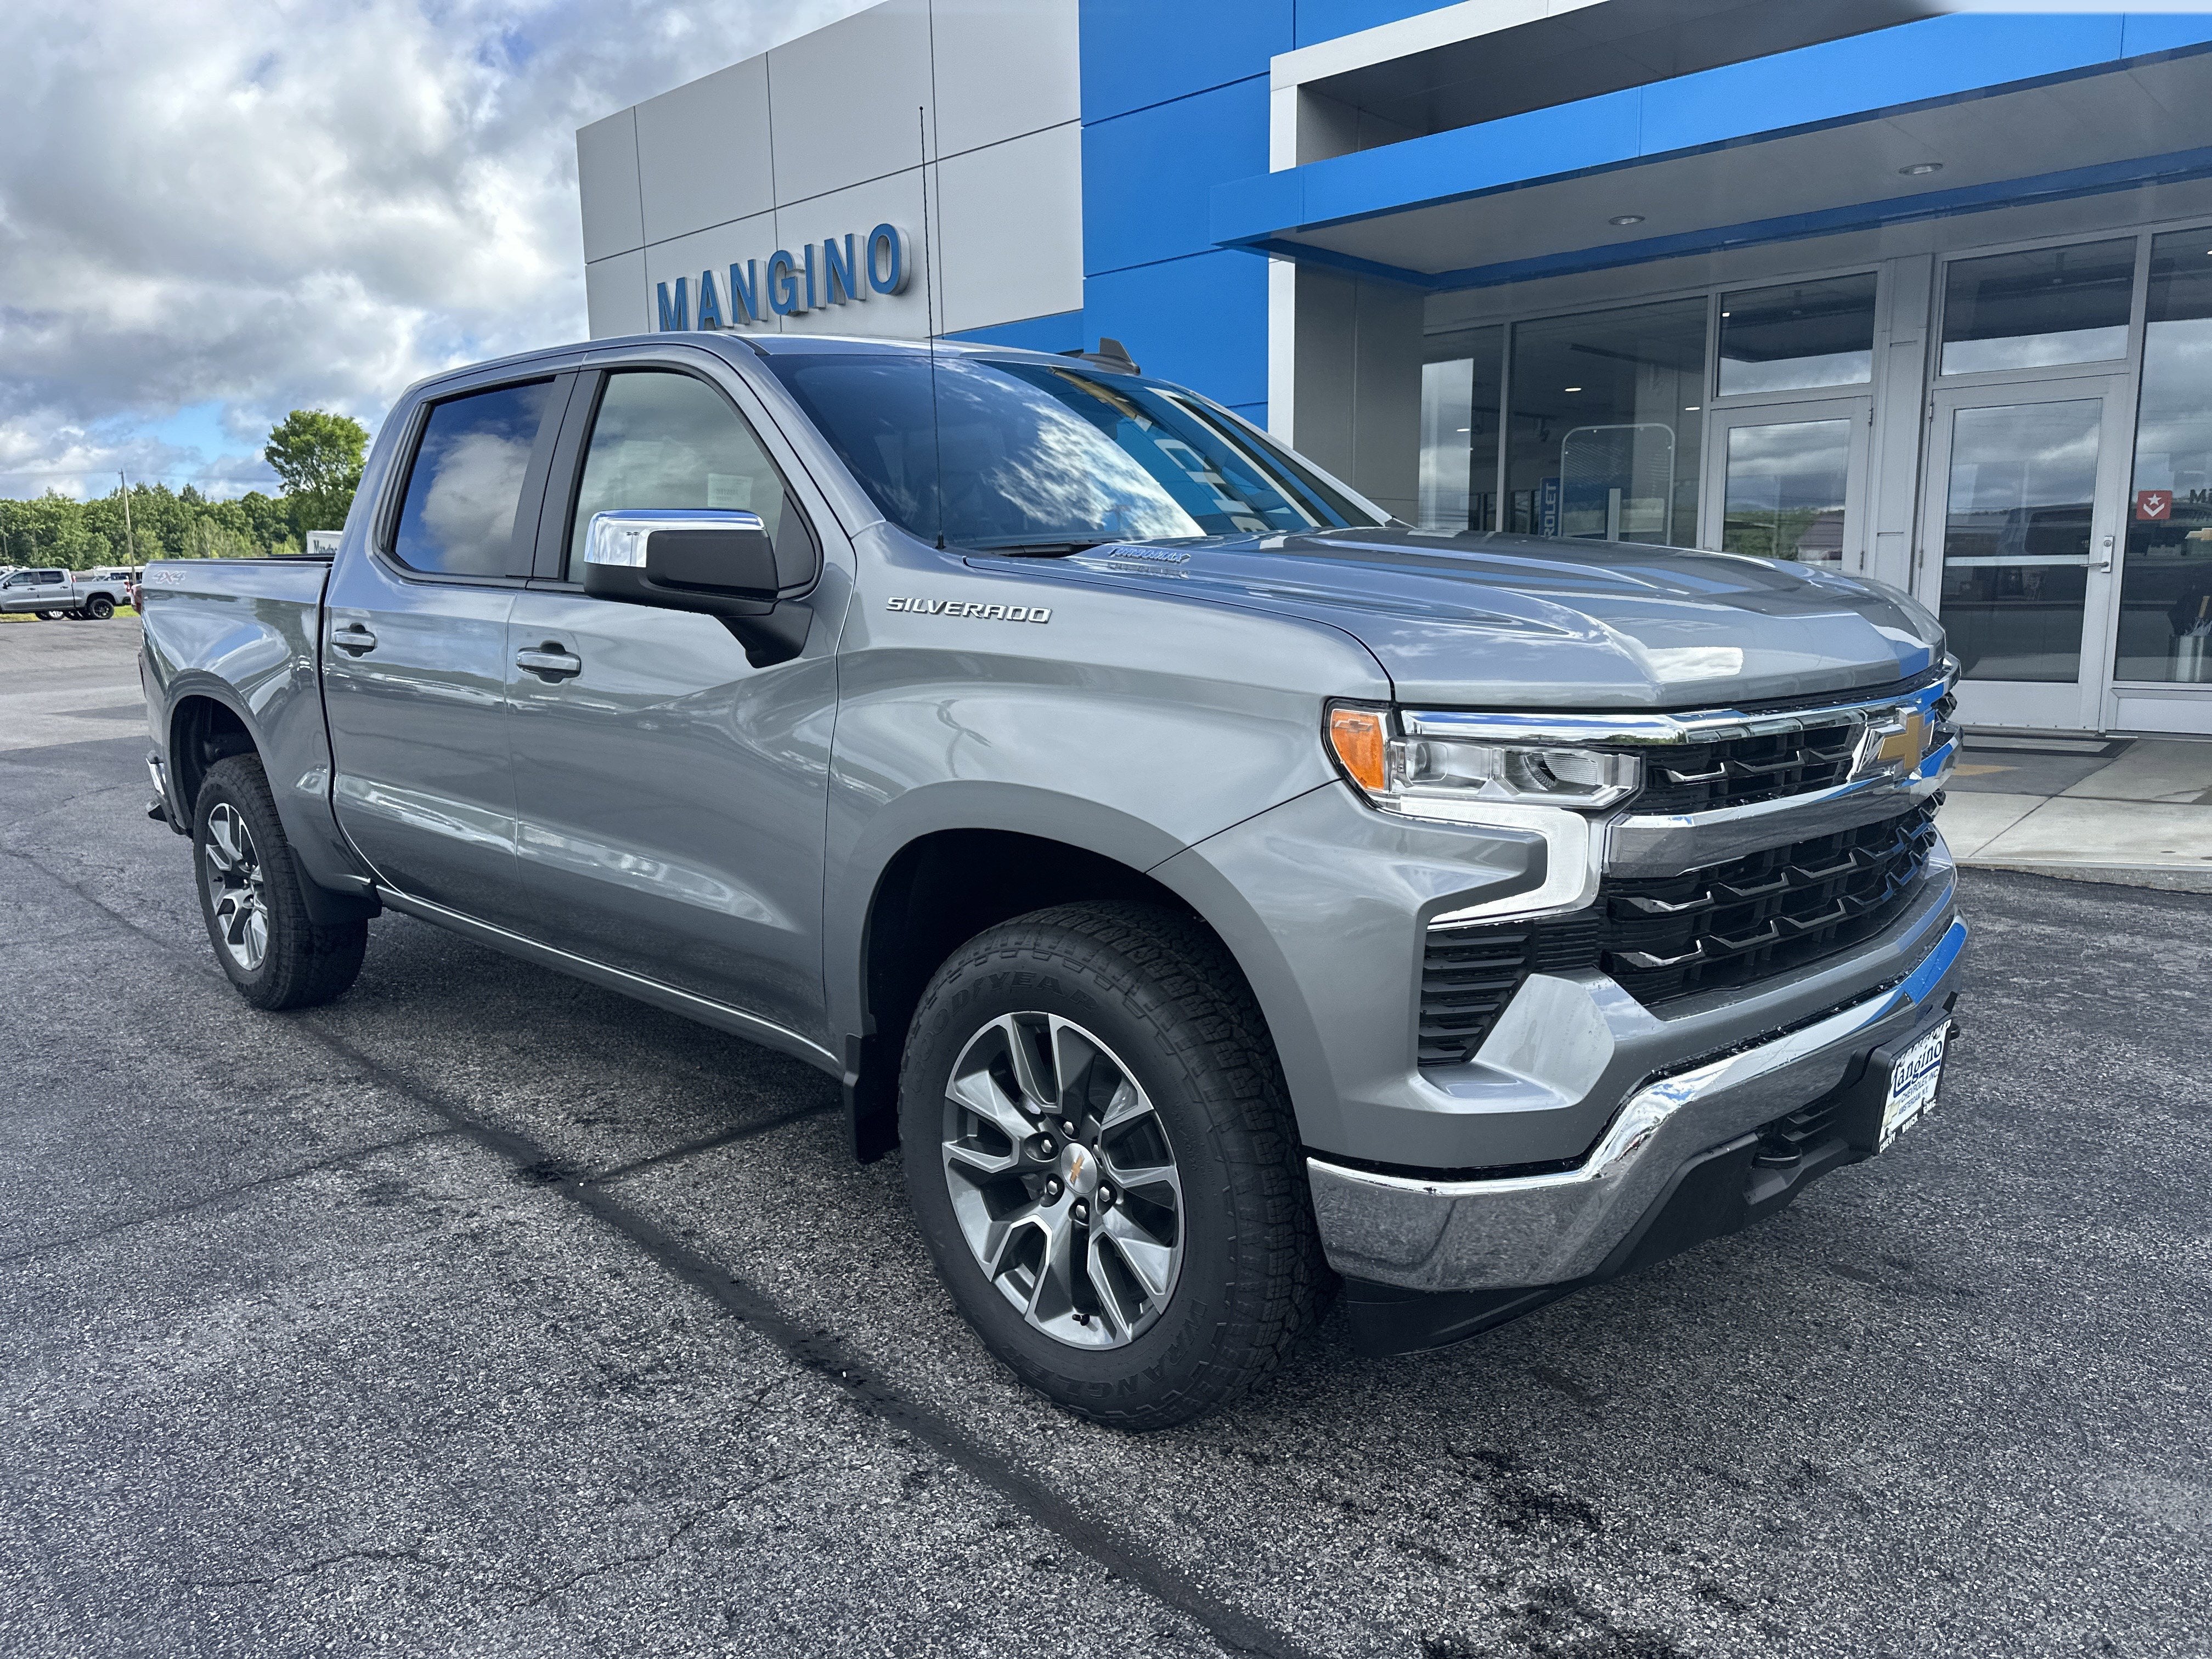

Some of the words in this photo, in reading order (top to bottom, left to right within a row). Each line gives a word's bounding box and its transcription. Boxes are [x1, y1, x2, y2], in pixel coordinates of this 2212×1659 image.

[657, 223, 911, 332] MANGINO
[1107, 546, 1191, 564] TURBOMAX
[886, 596, 1052, 624] SILVERADO
[1879, 1131, 1896, 1153] CHEVY
[1901, 1113, 1918, 1133] BUICK
[1923, 1098, 1937, 1115] GMC
